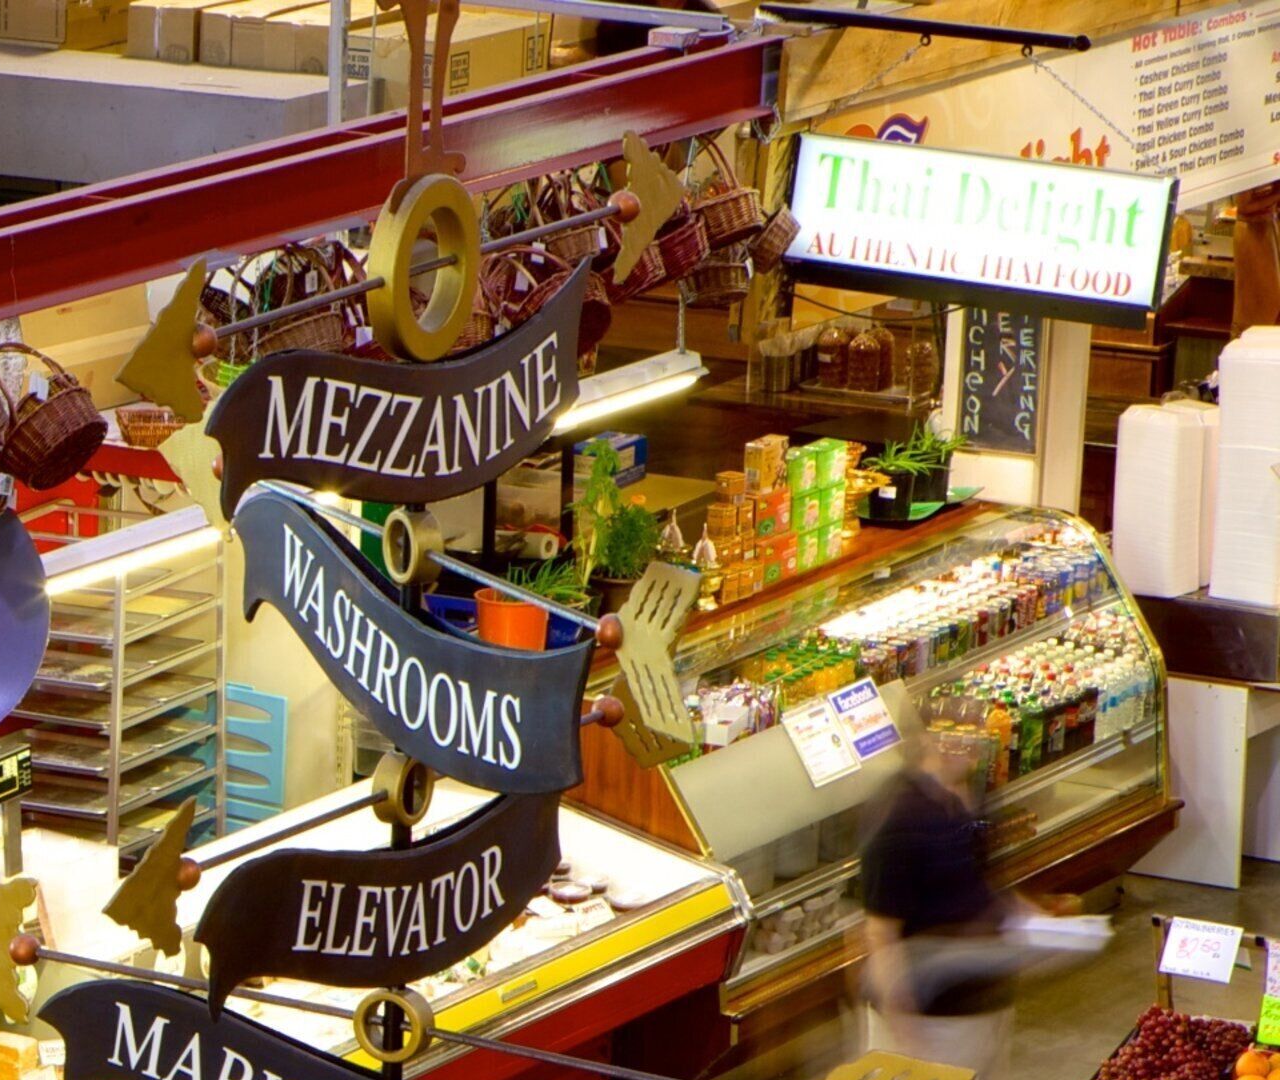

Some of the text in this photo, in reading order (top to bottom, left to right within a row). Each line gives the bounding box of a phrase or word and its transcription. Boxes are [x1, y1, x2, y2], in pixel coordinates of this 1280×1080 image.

[1132, 31, 1158, 53] Hot
[1163, 20, 1202, 44] Table:
[1207, 11, 1247, 31] Combos
[1139, 70, 1222, 101] Thai Red Curry Combo
[1140, 52, 1228, 87] Cashew Chicken Combo
[1137, 101, 1229, 137] Thai Yellow Curry Combo
[1138, 84, 1228, 120] Thai Green Curry Combo
[1135, 121, 1214, 154] Basil Chicken Combo
[1169, 146, 1186, 161] Sour
[1188, 136, 1217, 154] Chicken
[1219, 128, 1245, 145] Combo
[1179, 158, 1195, 173] Thai
[1197, 151, 1217, 167] Curry
[1219, 144, 1245, 161] Combo
[818, 152, 1143, 253] Thai Delight
[806, 231, 1132, 298] AUTHENTIC THAI FOOD
[259, 331, 562, 477] MEZZANINE
[282, 524, 523, 771] WASHROOMS
[292, 845, 505, 957] ELEVATOR
